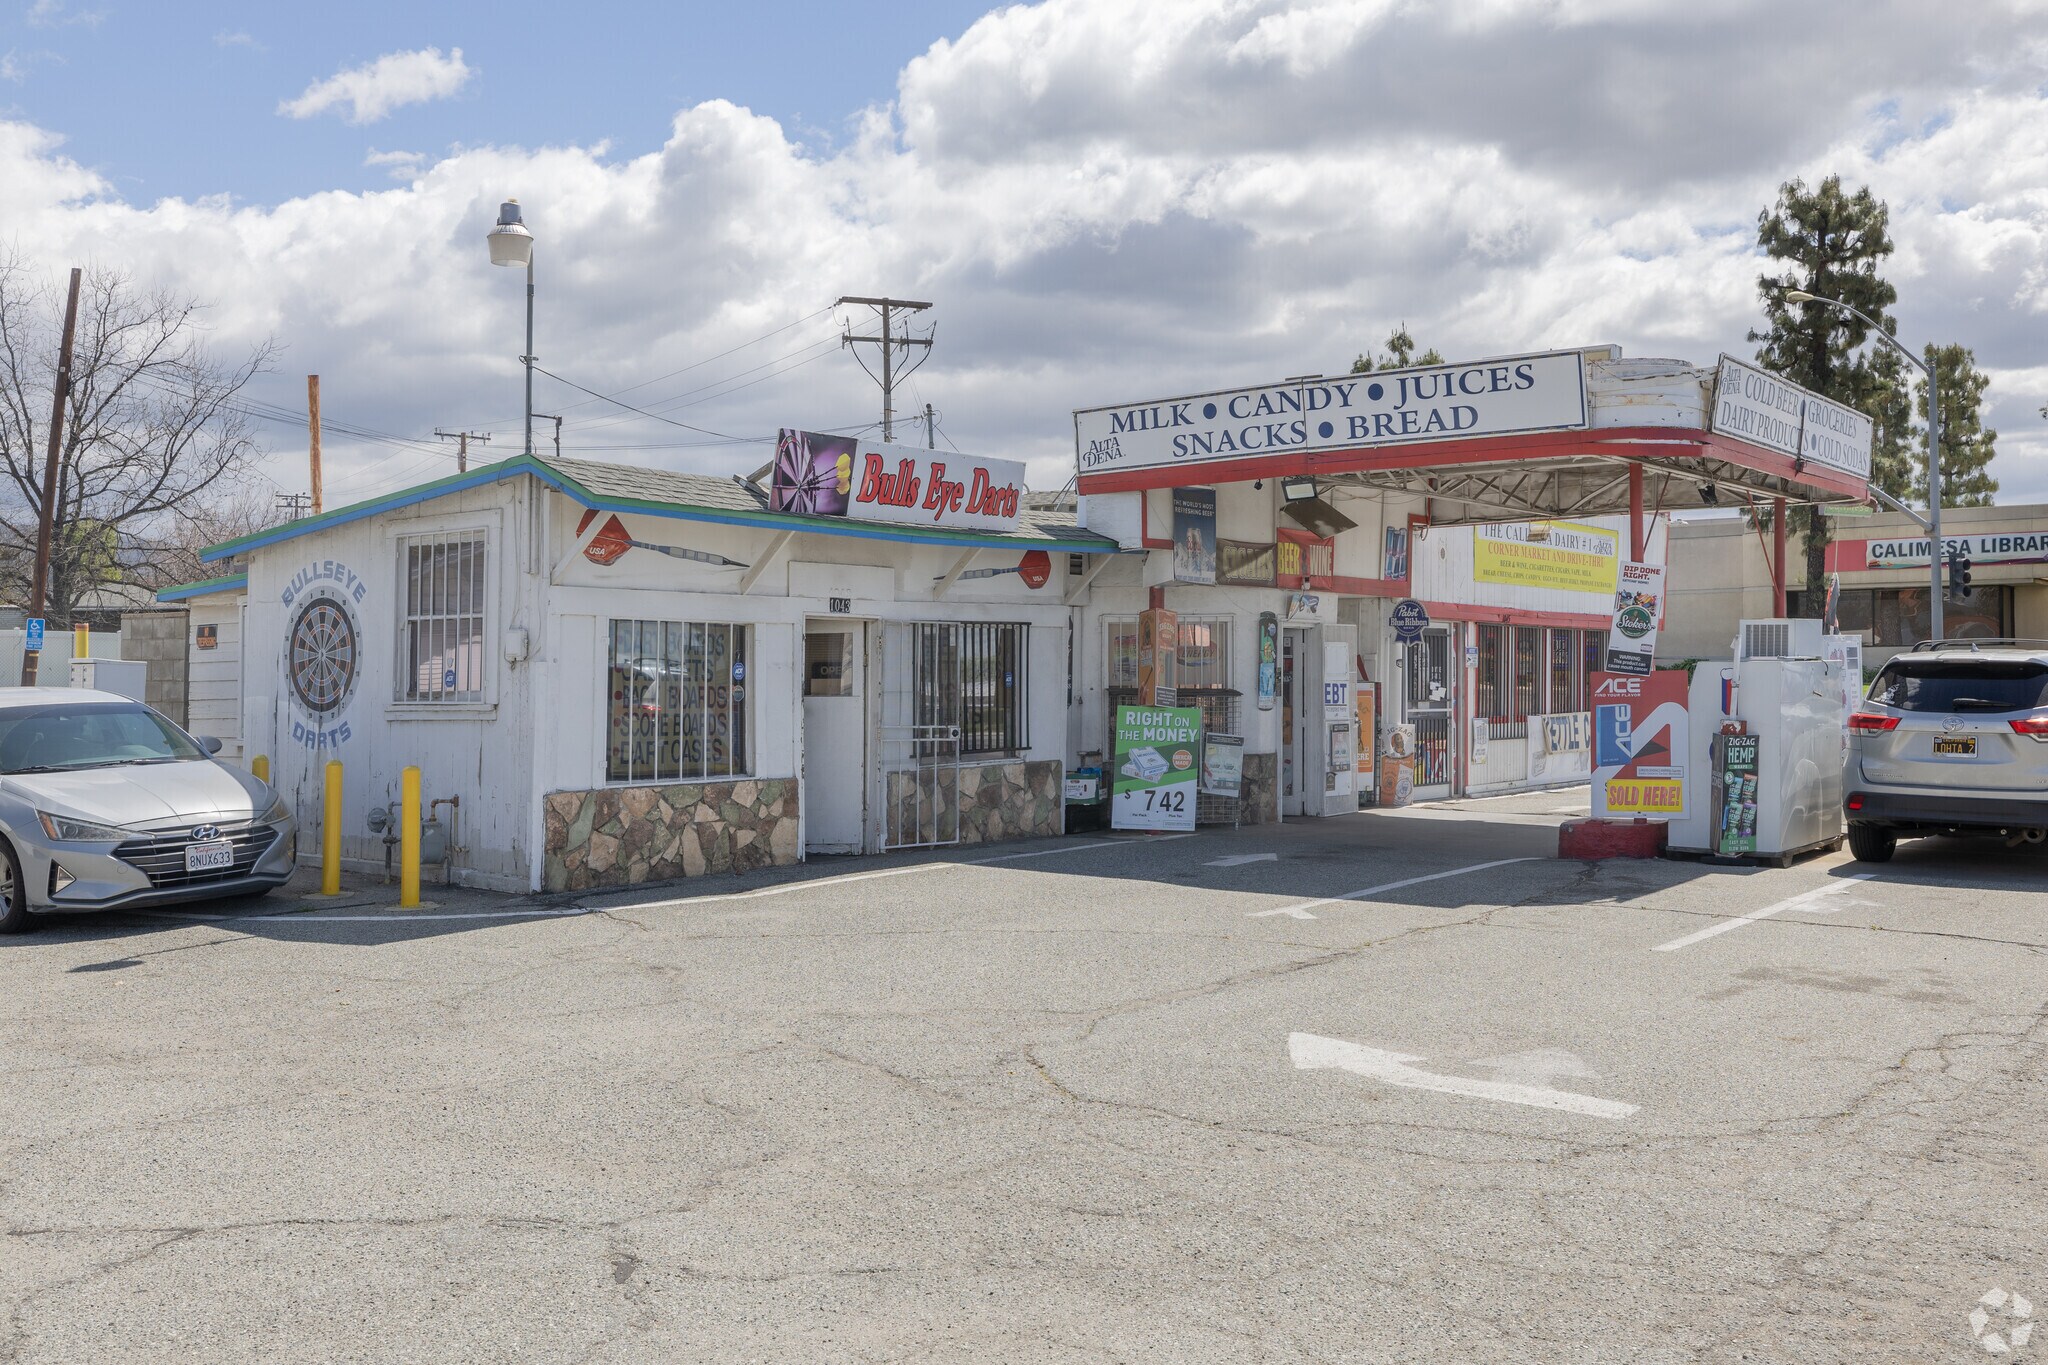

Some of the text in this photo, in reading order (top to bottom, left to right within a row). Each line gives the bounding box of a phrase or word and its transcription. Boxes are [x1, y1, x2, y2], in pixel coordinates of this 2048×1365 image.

[1110, 364, 1535, 434] MILK CANDY JUICES
[1745, 373, 1857, 438] COLD BEER GROCERIES
[1172, 404, 1479, 458] SNACKS BREAD
[1721, 401, 1868, 471] DAIRY PRODUCTS COLD SODAS
[1089, 436, 1121, 455] ALTA
[856, 452, 1019, 521] Bulls Eye Darts
[1484, 524, 1502, 538] THE
[1555, 533, 1581, 550] DAIRY
[589, 547, 605, 555] USA
[1278, 541, 1300, 575] BEER
[1309, 544, 1332, 576] WINE
[1488, 541, 1605, 568] CORNER MARKET AND DRIVE-THRU
[1222, 544, 1275, 582] CIGARS
[1624, 565, 1661, 575] DIP DONE
[281, 560, 366, 608] BULLSEYE
[1623, 572, 1650, 580] RIGHT.
[830, 598, 850, 613] 1043
[1398, 605, 1419, 617] Pabst
[1390, 618, 1427, 626] Blue Ribbon
[1616, 614, 1656, 632] Stoker's
[667, 632, 725, 656] BOARDS
[821, 666, 842, 677] OPE
[1324, 683, 1347, 704] EBT
[1594, 678, 1646, 693] ACE
[668, 686, 727, 709] BOARDS
[620, 713, 727, 737] SCORE BOARDS
[1126, 711, 1190, 727] RIGHT ON
[292, 721, 352, 749] DARTS
[1119, 730, 1140, 741] THE
[1143, 727, 1198, 743] MONEY
[1615, 704, 1632, 758] ACE
[1729, 738, 1755, 746] ZIG-ZAG
[620, 738, 722, 765] DART CASES
[1728, 747, 1755, 763] HEMP
[1124, 789, 1185, 813] $ 7.42
[1609, 785, 1680, 806] SOLD HERE!
[190, 851, 230, 867] 8NUX633
